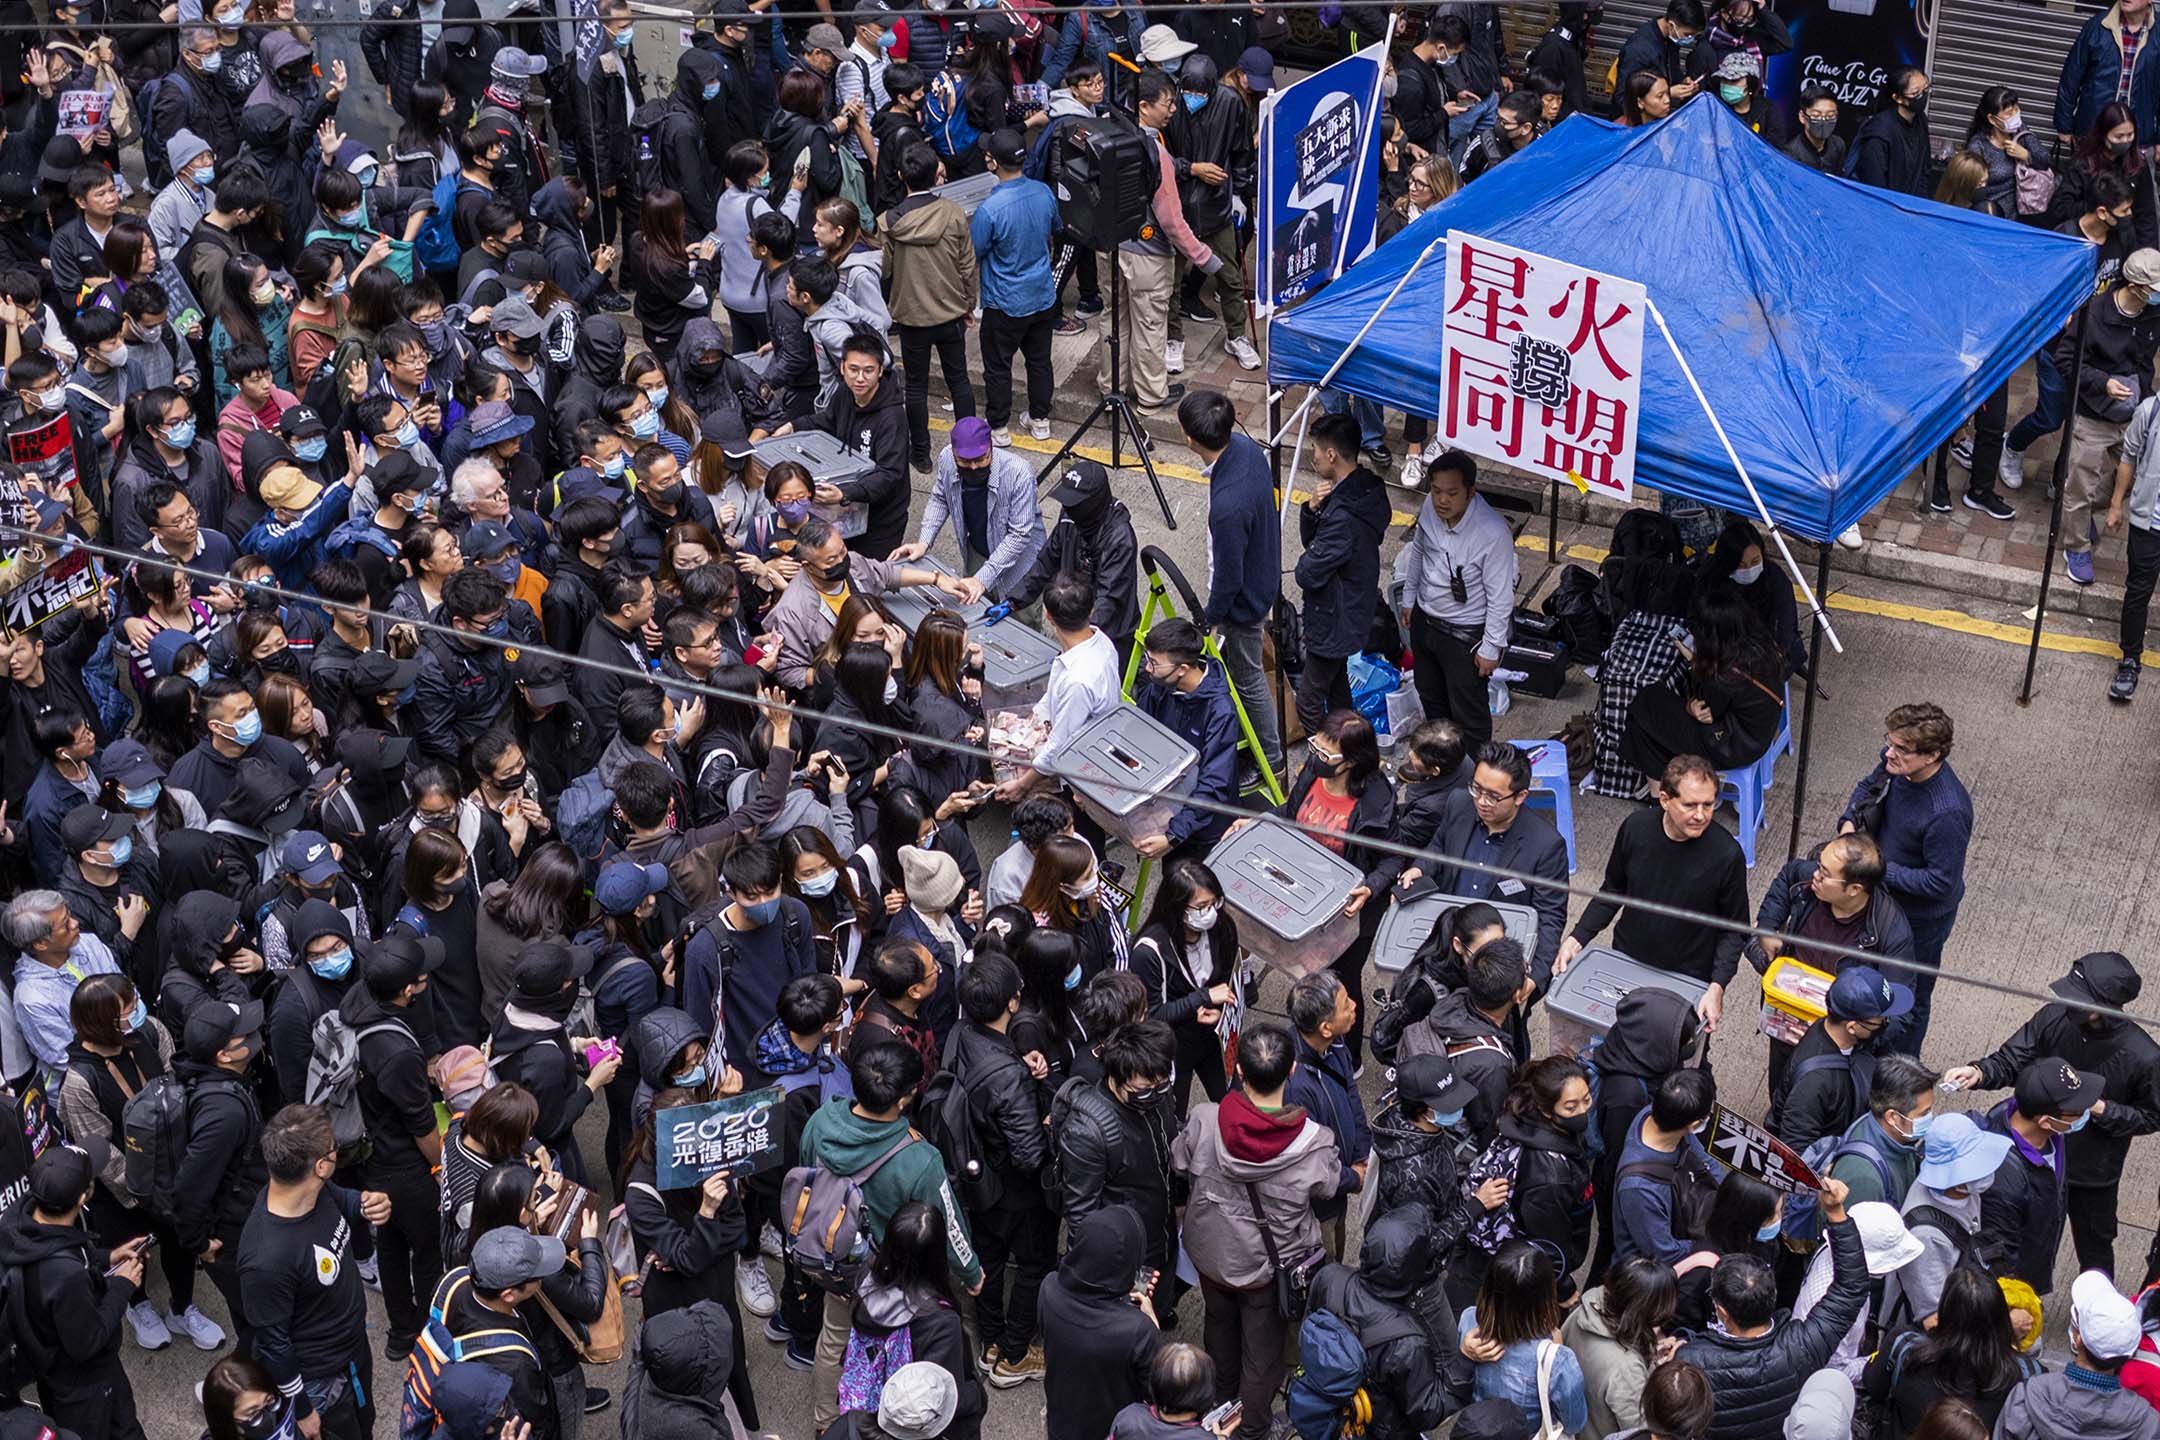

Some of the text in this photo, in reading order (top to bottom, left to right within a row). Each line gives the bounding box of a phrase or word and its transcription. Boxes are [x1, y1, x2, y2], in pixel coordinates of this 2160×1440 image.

[1803, 55, 1841, 76] Time
[1845, 62, 1866, 81] To
[1302, 106, 1351, 159] 五大訴求
[1302, 126, 1351, 179] 缺一不可
[1446, 242, 1632, 382] 星火
[13, 424, 58, 447] FREE
[1445, 346, 1629, 492] 同盟
[15, 445, 45, 459] HK
[7, 567, 95, 627] 不忘記
[673, 1101, 770, 1143] 2020
[1719, 1109, 1770, 1149] 我們
[671, 1127, 769, 1168] 光復香港
